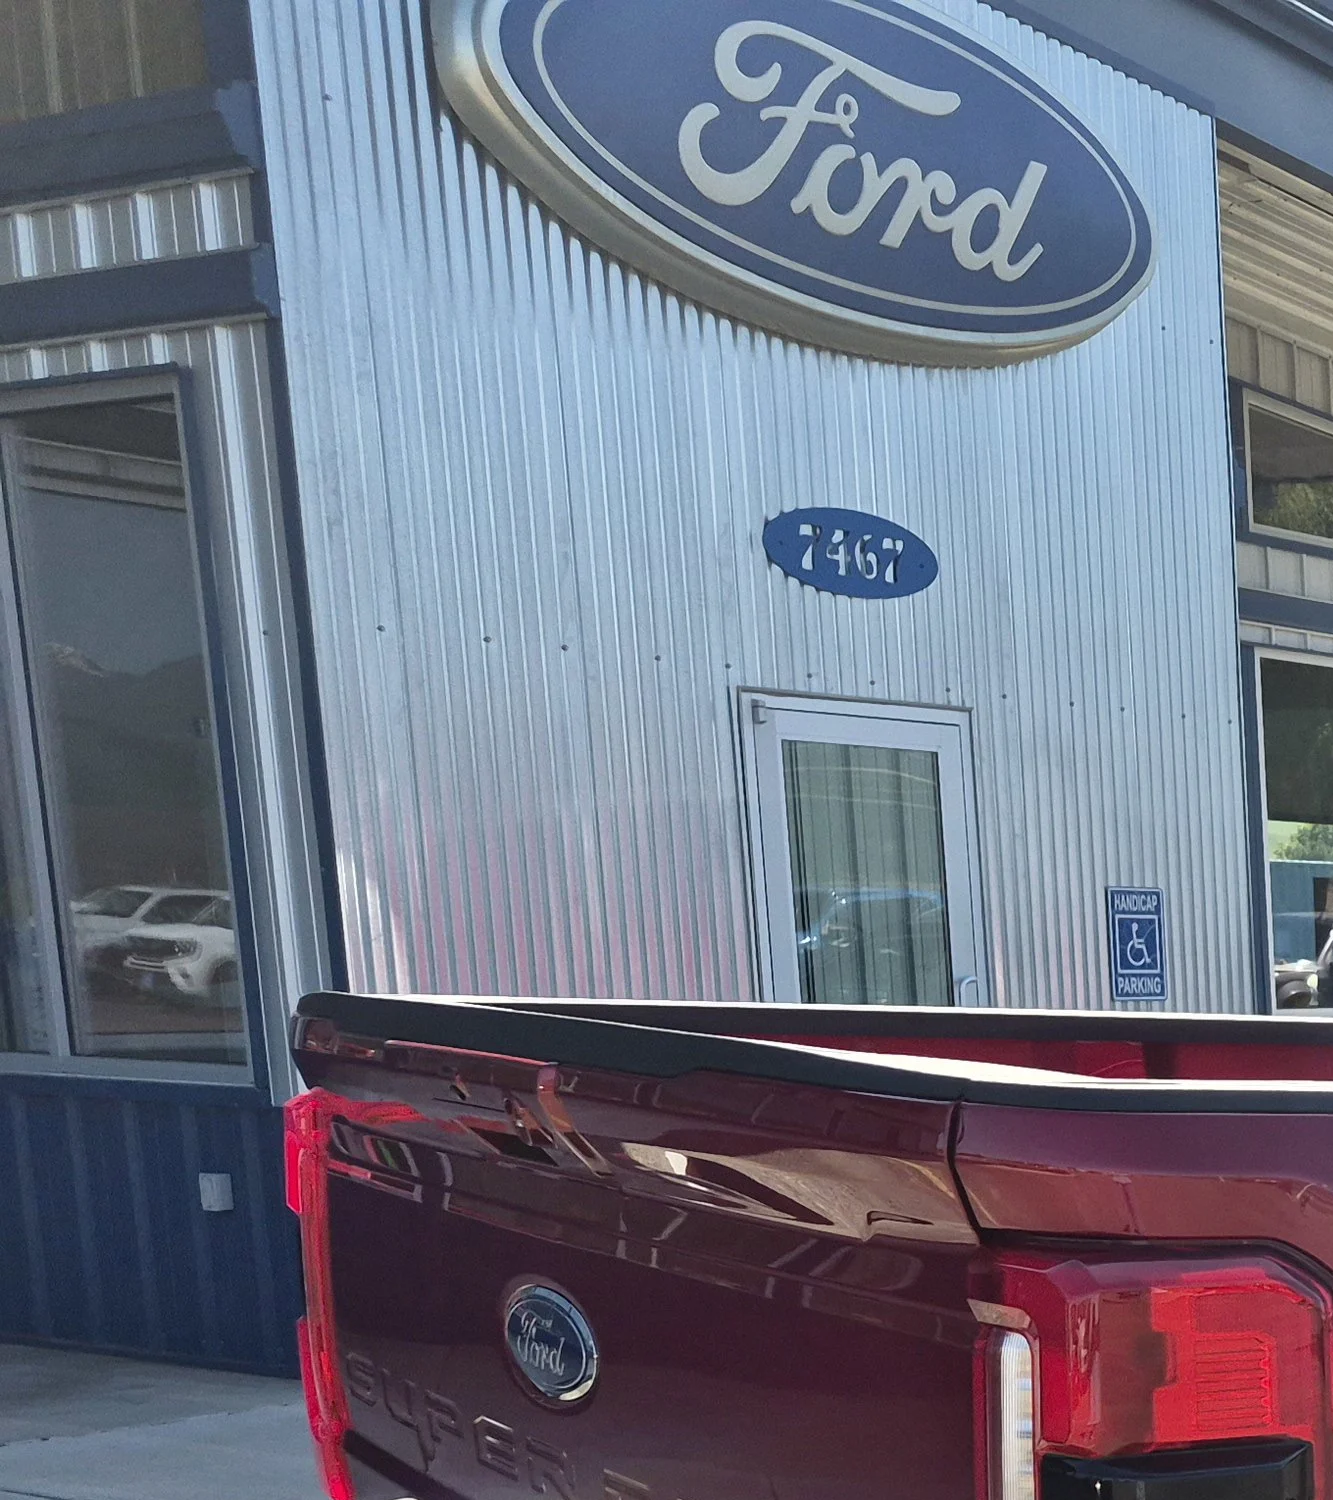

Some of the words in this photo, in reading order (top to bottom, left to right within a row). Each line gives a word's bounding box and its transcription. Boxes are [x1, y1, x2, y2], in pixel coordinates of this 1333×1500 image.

[678, 20, 1048, 282] Ford
[798, 523, 905, 584] 7467
[1113, 893, 1158, 912] HANDICAP
[1117, 976, 1162, 994] PARKING
[516, 1310, 566, 1377] Ford
